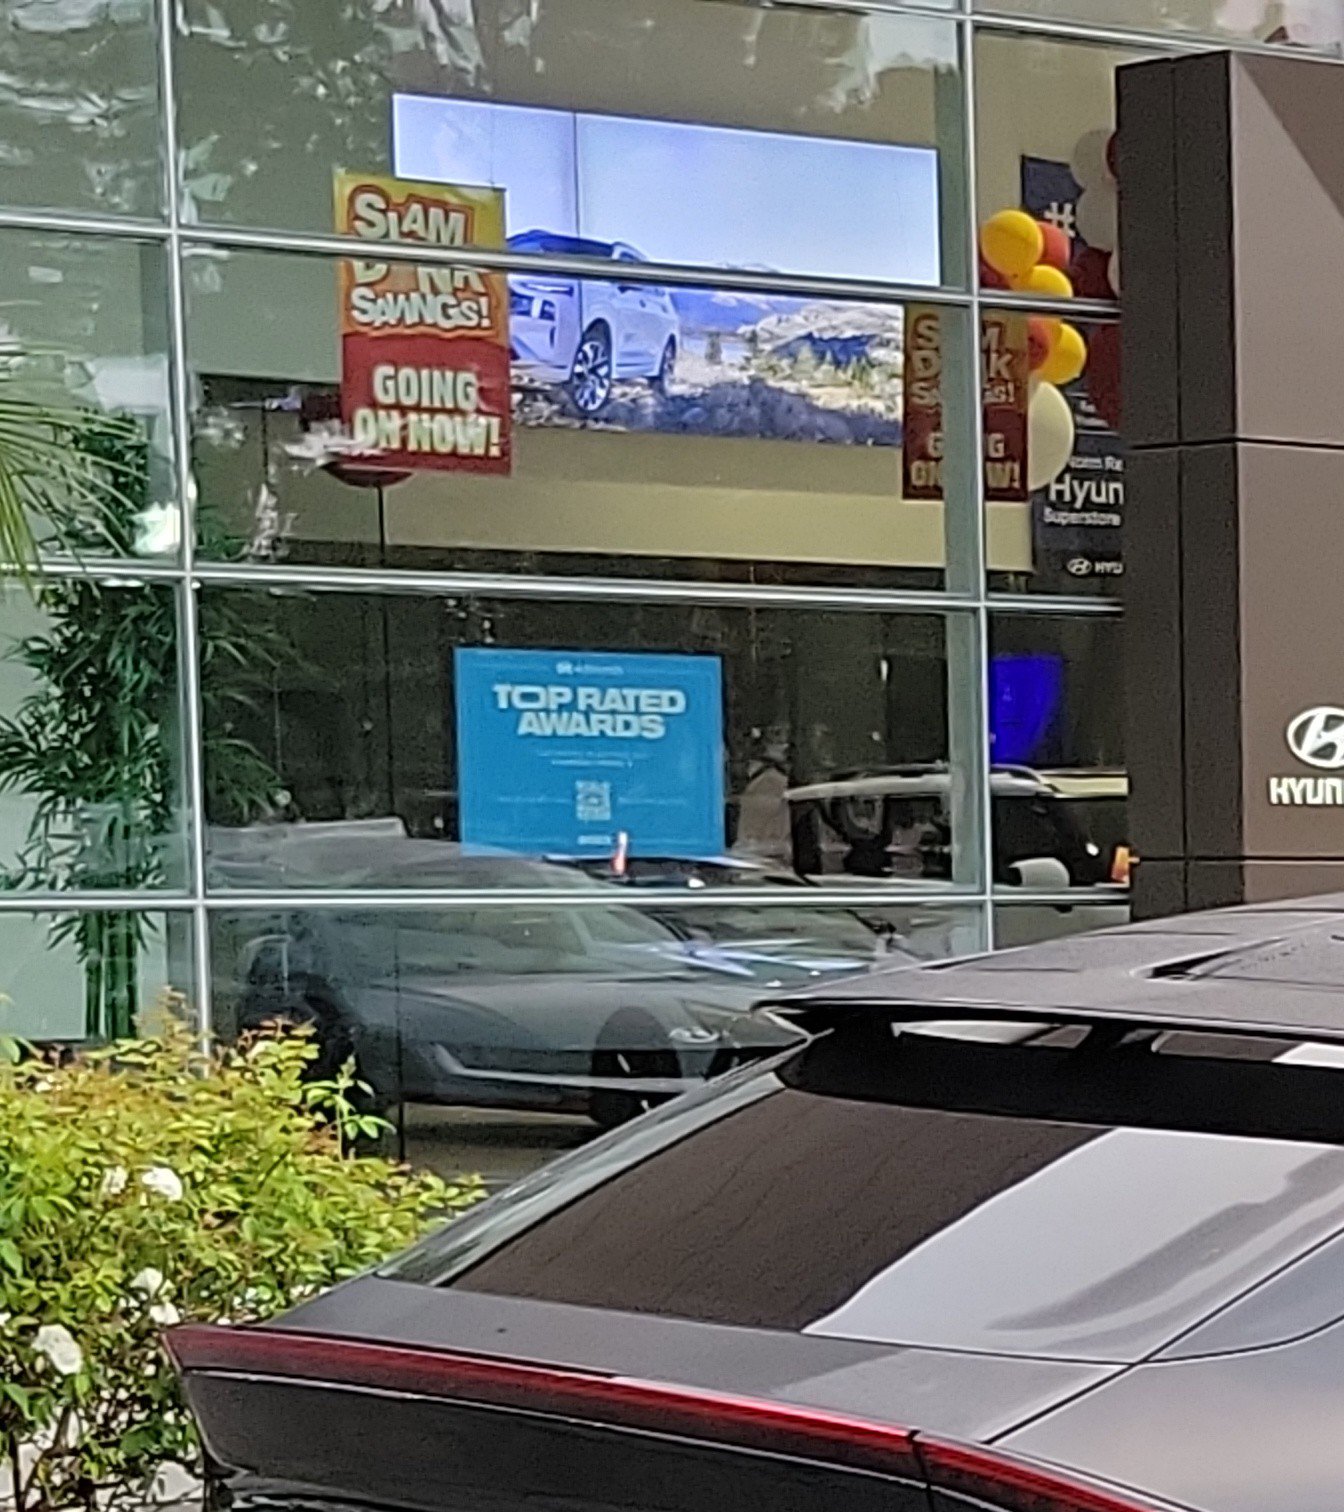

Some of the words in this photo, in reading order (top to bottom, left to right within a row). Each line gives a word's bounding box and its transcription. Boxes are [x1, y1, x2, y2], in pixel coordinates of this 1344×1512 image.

[373, 365, 478, 411] GOING
[353, 408, 400, 450] ON
[407, 412, 501, 458] NOW!
[1049, 474, 1124, 509] Hyun
[492, 684, 573, 710] TOP
[578, 687, 686, 714] RATED
[517, 712, 666, 739] AWARDS
